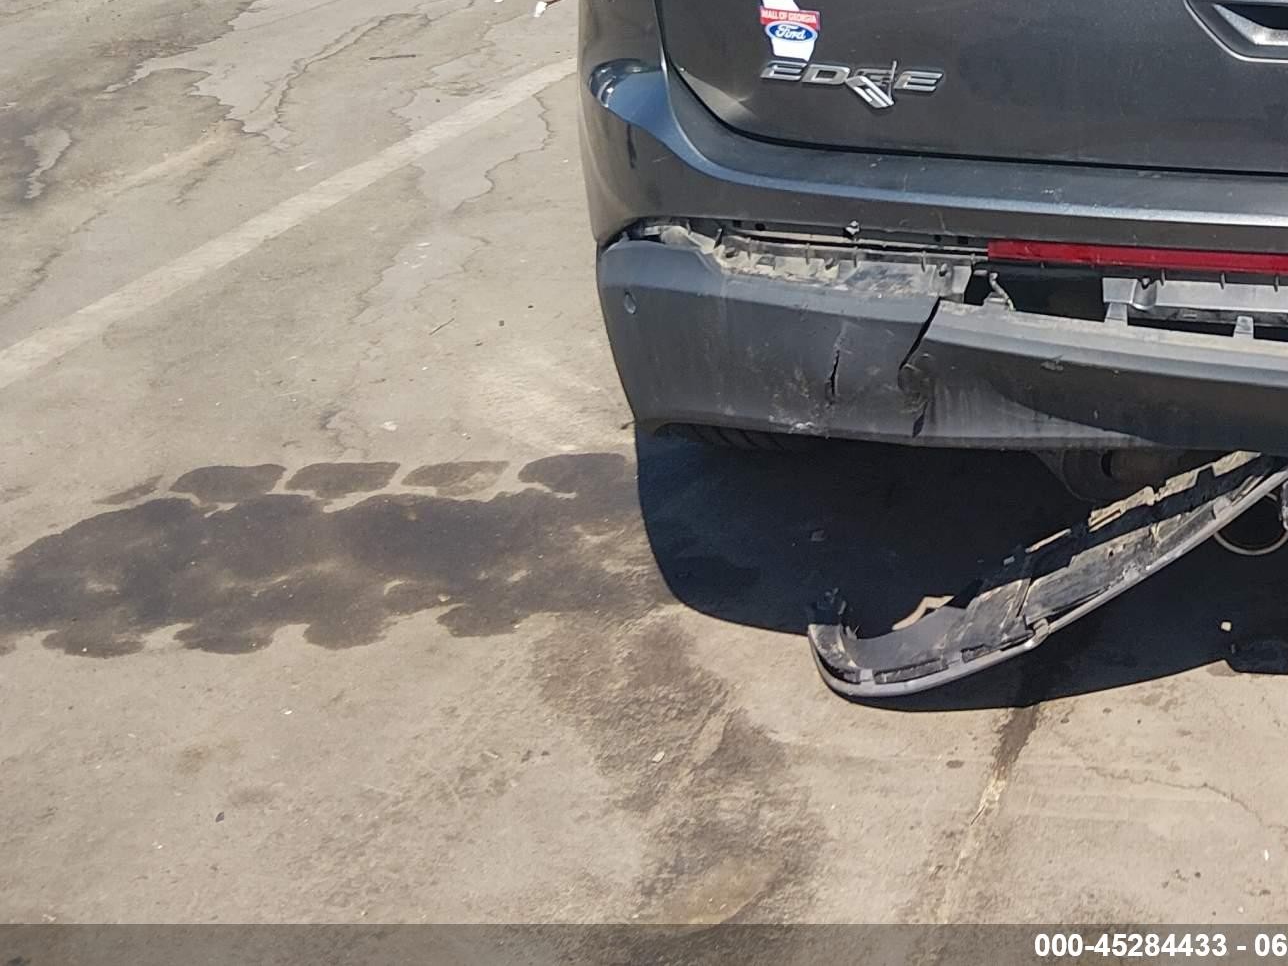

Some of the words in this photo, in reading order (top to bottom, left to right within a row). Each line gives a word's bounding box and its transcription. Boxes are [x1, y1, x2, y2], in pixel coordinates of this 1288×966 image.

[761, 10, 779, 20] MALL
[779, 11, 788, 20] OF
[788, 12, 817, 24] GEORGIA
[775, 24, 807, 40] Ford
